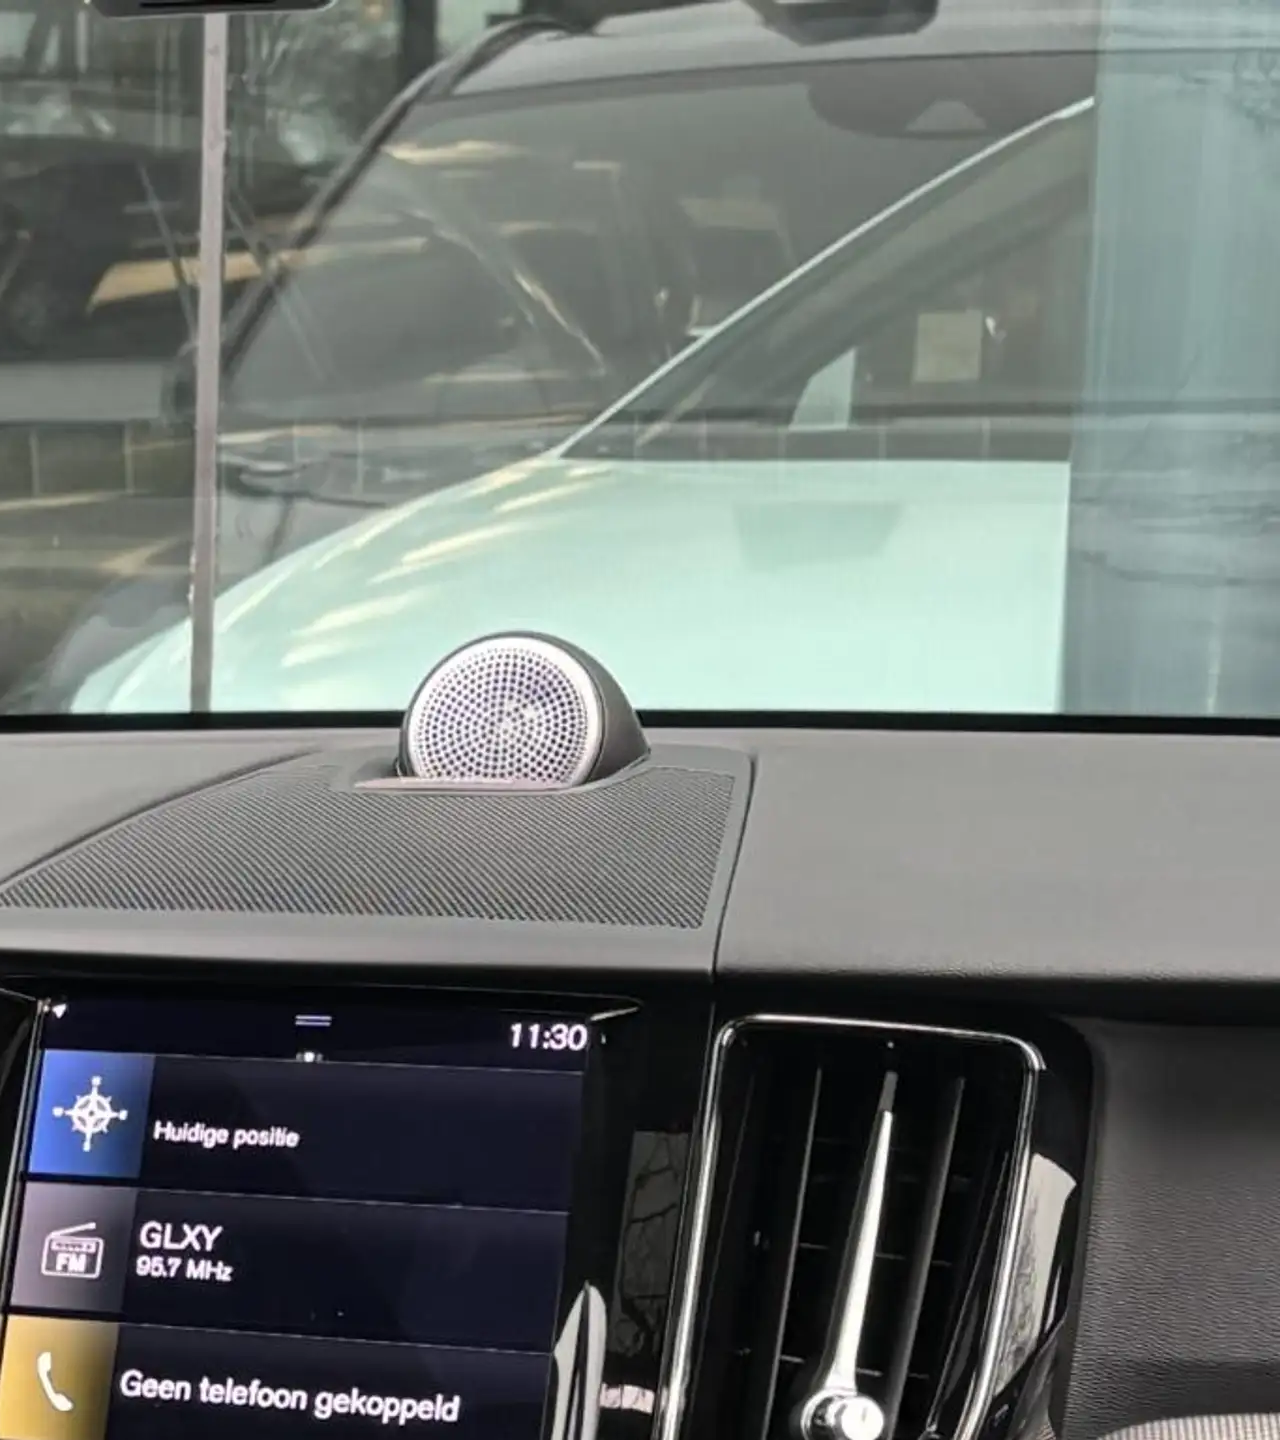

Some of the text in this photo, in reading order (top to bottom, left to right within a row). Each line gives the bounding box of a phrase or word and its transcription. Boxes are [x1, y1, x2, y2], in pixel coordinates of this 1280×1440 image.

[510, 1022, 588, 1051] 11:30
[153, 1119, 301, 1150] Huidige positie
[139, 1220, 223, 1252] GLXY
[55, 1253, 87, 1273] FM
[185, 1260, 233, 1282] MHz
[120, 1369, 461, 1426] Geen telefoon gekoppeld
